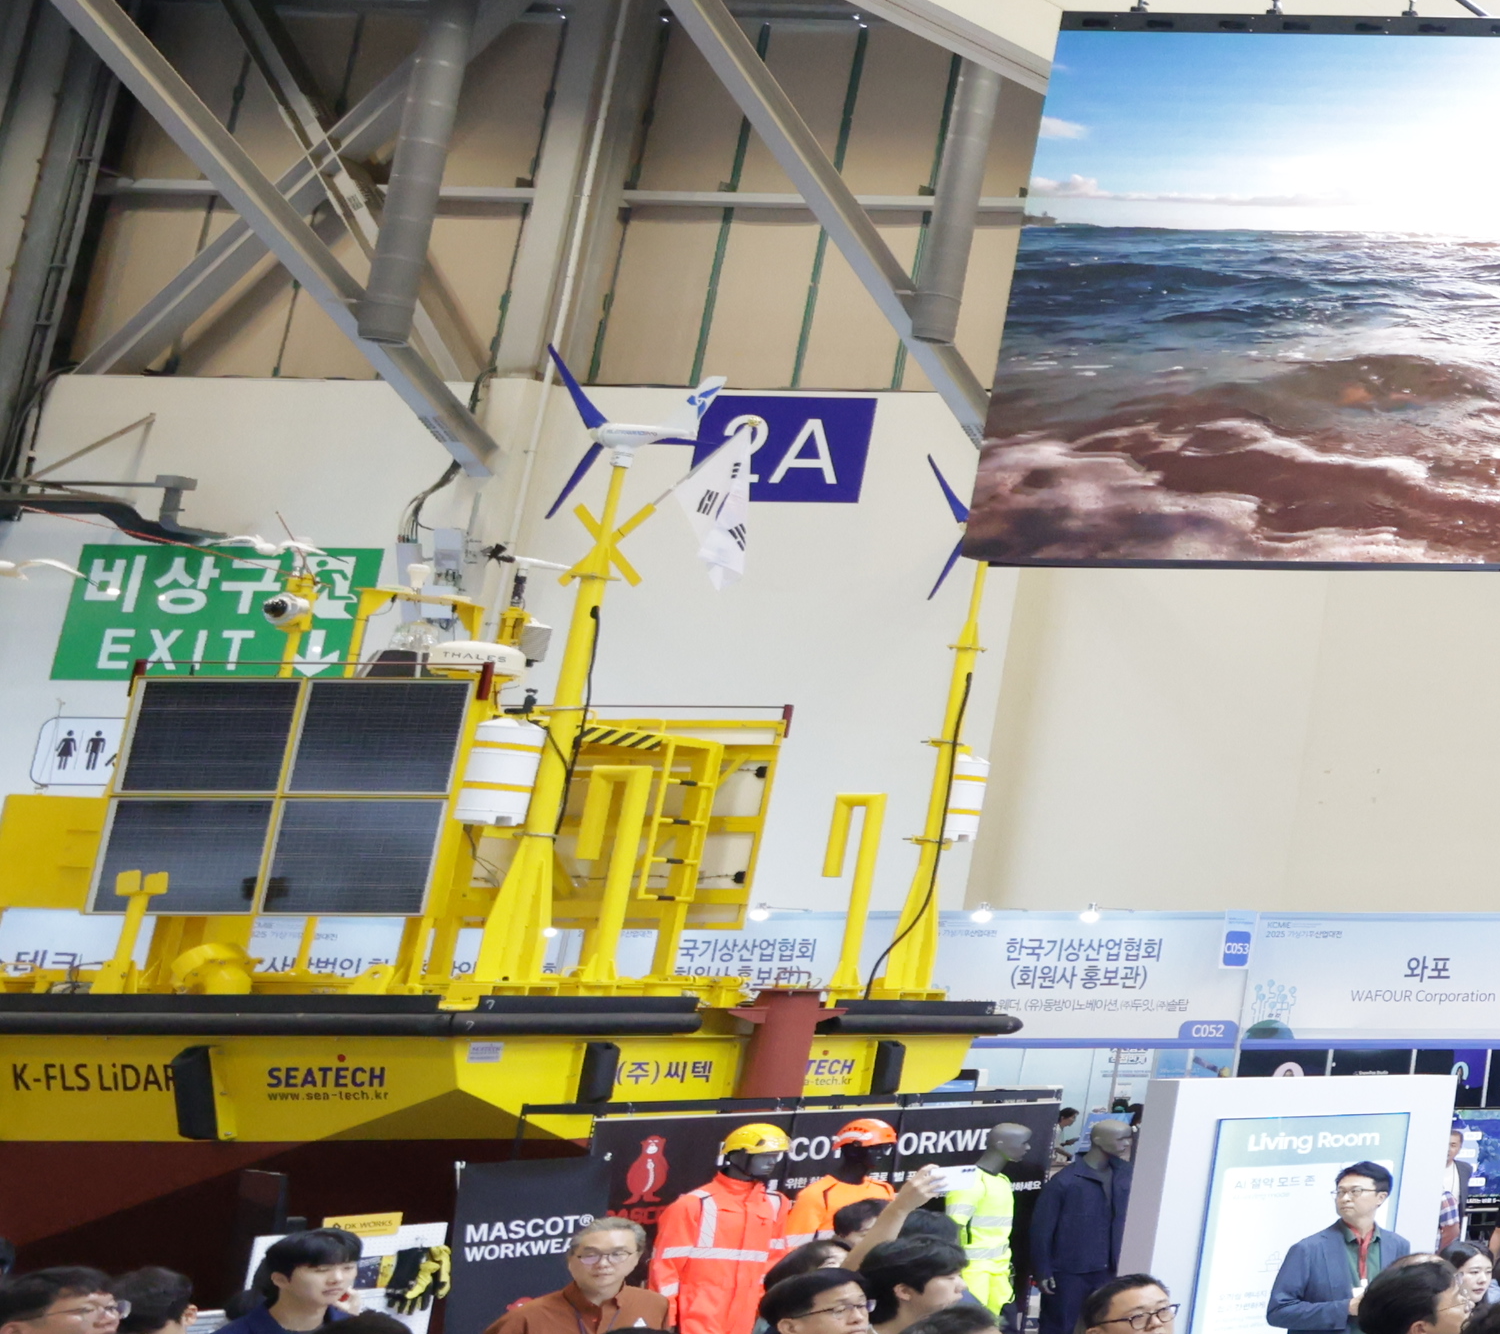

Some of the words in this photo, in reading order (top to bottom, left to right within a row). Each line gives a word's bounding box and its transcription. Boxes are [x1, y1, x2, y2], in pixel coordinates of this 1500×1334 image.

[724, 414, 838, 485] 2A
[84, 555, 282, 615] 비상구
[96, 628, 256, 670] EXIT
[443, 651, 507, 663] THALES
[1265, 930, 1285, 938] 2025
[678, 938, 817, 963] 국기상산업협회
[1005, 937, 1163, 963] 한국기상산업협회
[1224, 942, 1249, 955] C053
[1010, 965, 1077, 990] (회원사
[1080, 965, 1148, 990] 홍보관)
[1404, 955, 1450, 983] 와포
[1351, 989, 1412, 1003] WAFOUR
[1415, 989, 1496, 1005] Corporation
[1192, 1024, 1224, 1038] C052
[12, 1064, 90, 1092] K-FLS
[267, 1066, 386, 1088] SEATECH
[617, 1060, 713, 1085] (주)씨텍
[804, 1059, 855, 1076] TECH
[804, 1076, 852, 1086] a-tech.kr
[267, 1091, 389, 1102] www.sea-tech.kr
[884, 1128, 990, 1156] ORKWE
[1248, 1132, 1313, 1154] Living
[1317, 1131, 1380, 1148] Room
[1251, 1178, 1274, 1189] 절약
[1277, 1177, 1300, 1188] 모드
[1304, 1175, 1316, 1186] 존
[464, 1237, 573, 1262] WORKWEA
